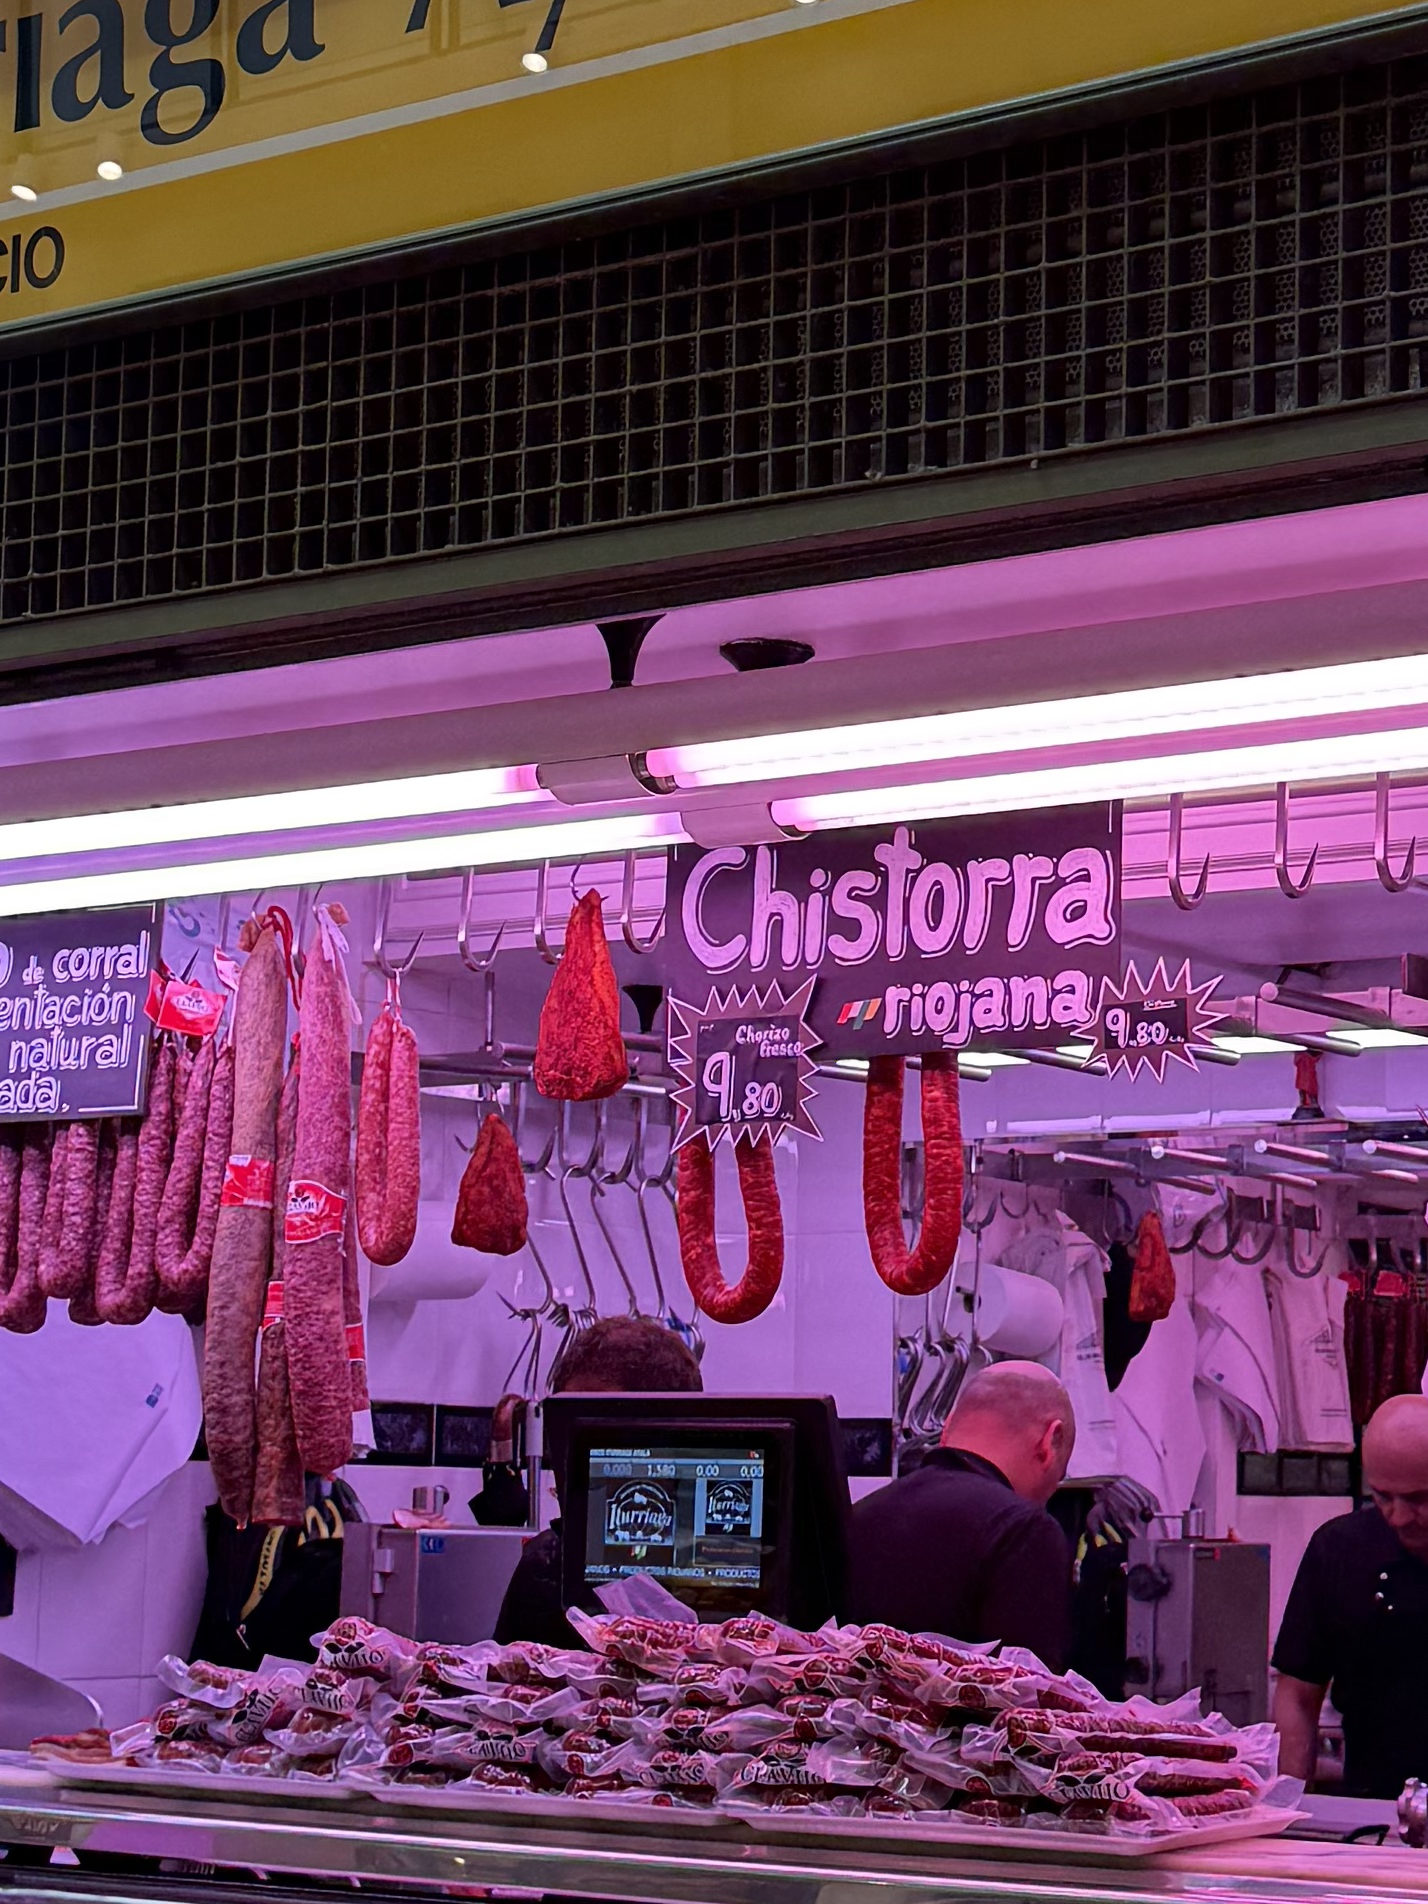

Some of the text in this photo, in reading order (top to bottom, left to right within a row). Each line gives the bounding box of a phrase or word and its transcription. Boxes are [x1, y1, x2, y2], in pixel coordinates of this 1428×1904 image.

[682, 826, 1116, 976] Chistorra
[22, 955, 44, 985] de
[52, 930, 150, 983] corral
[736, 1024, 790, 1044] Chorizo
[883, 969, 1097, 1049] riojana
[10, 1022, 132, 1074] natural
